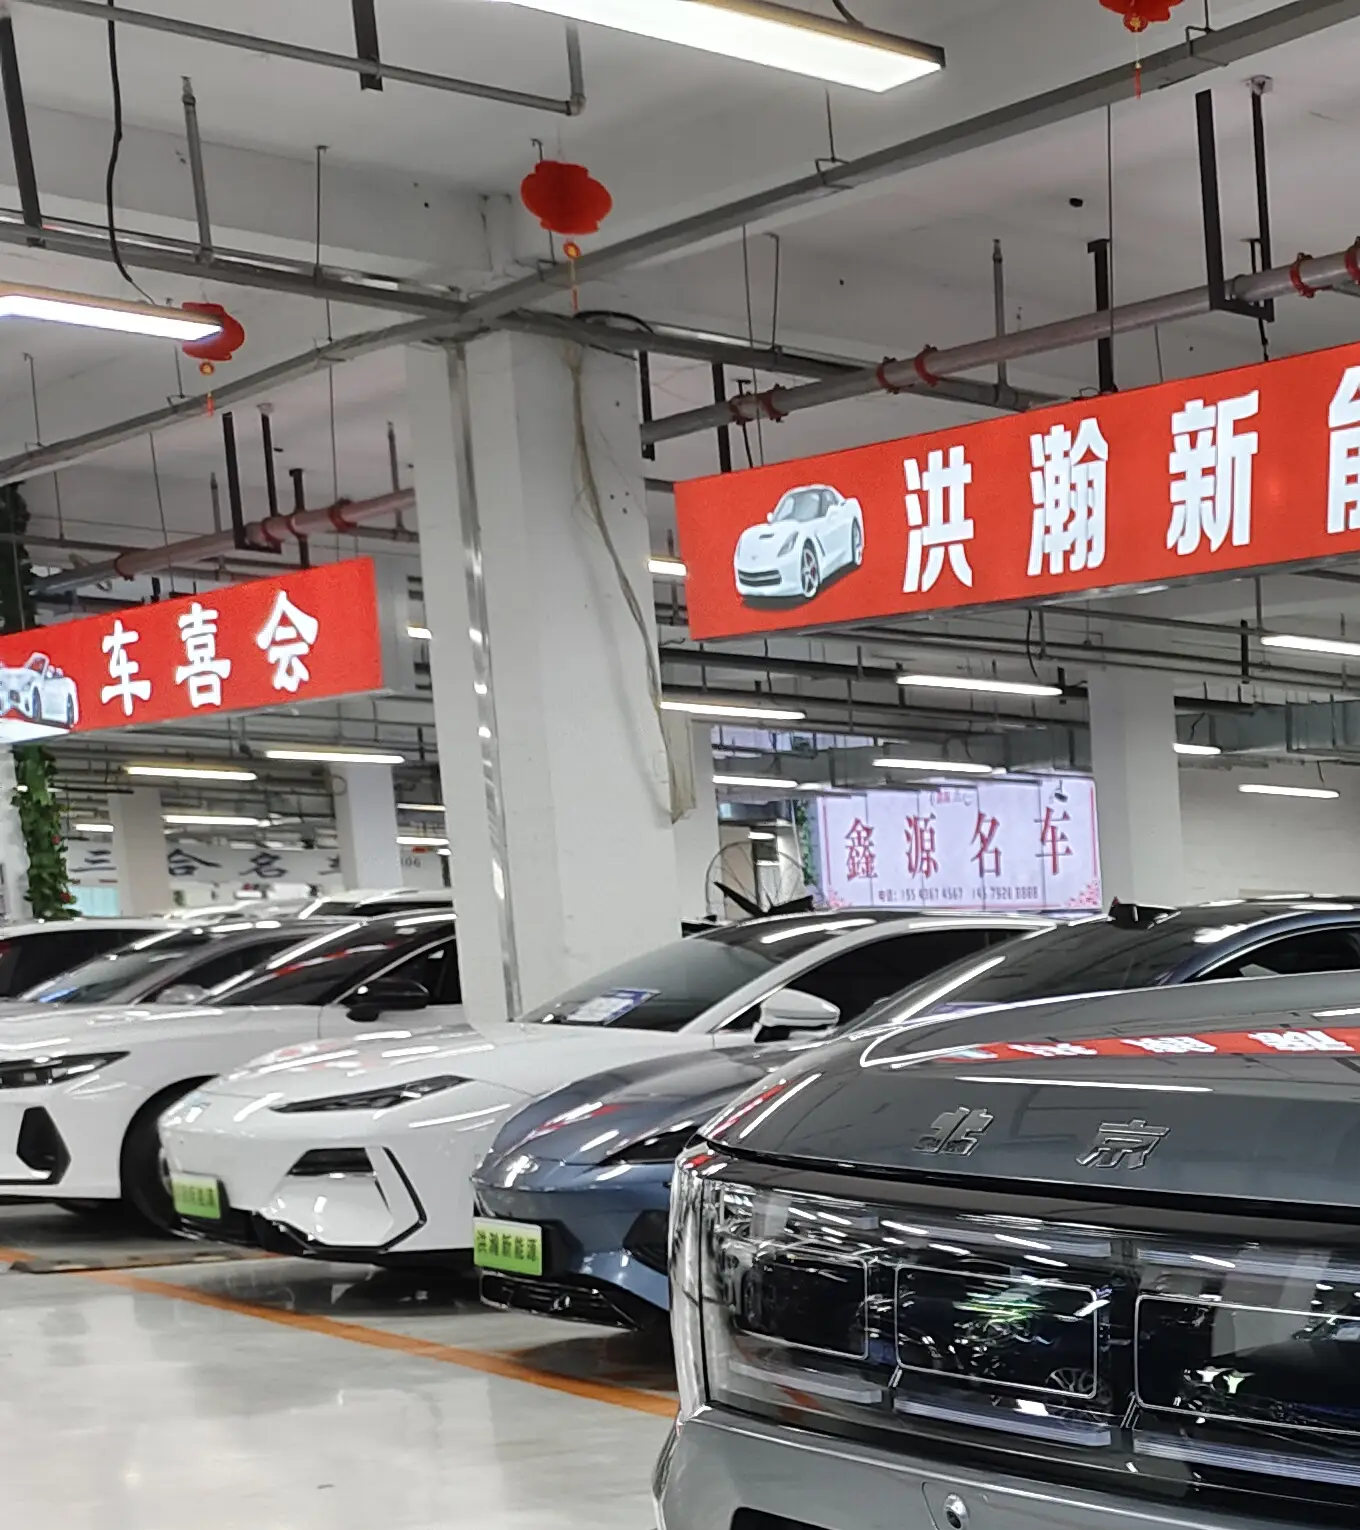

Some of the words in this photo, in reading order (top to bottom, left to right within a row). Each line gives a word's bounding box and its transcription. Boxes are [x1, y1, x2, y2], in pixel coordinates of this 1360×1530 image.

[100, 588, 320, 715] 车喜会
[845, 808, 1074, 882] 鑫源名车
[912, 1105, 1171, 1169] 北京
